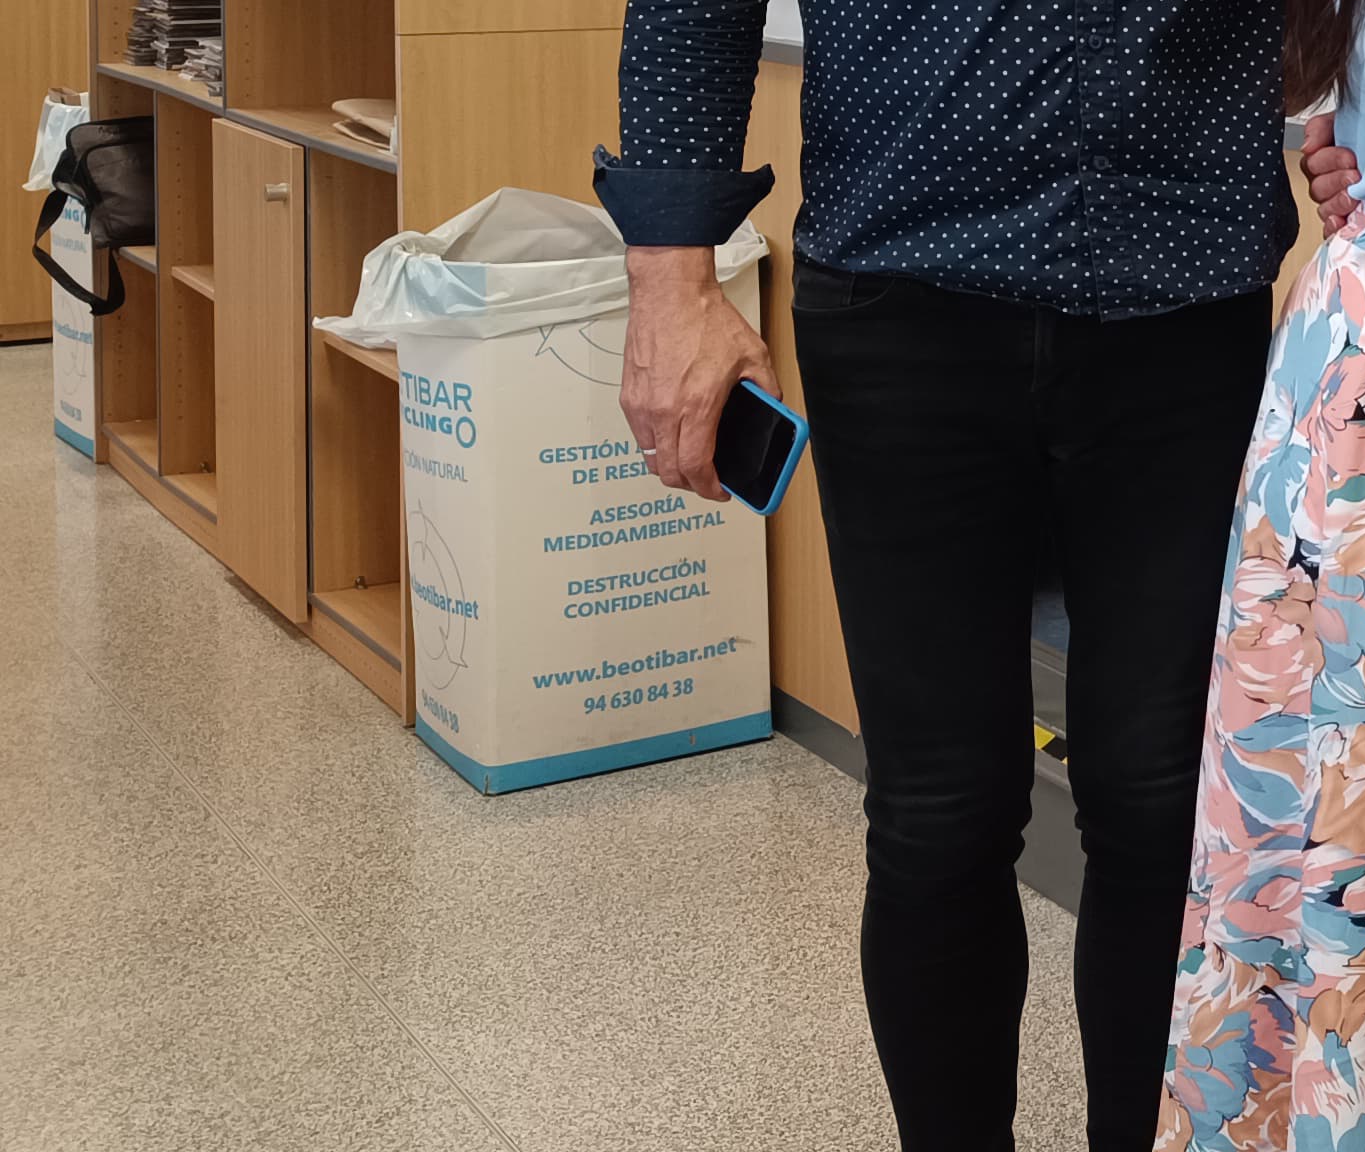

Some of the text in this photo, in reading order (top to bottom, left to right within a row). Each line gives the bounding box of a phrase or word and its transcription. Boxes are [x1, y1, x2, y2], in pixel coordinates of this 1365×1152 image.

[400, 370, 473, 413] TIBAR
[538, 439, 630, 464] GESTIÓN
[572, 460, 650, 485] DE RESI
[589, 494, 686, 526] ASESORÍA
[543, 510, 726, 553] MEDIOAMBIENTAL
[567, 558, 707, 596] DESTRUCCIÓN
[563, 581, 711, 619] CONFIDENCIAL
[532, 637, 738, 690] www.beotibar.net
[583, 678, 694, 714] 94 630 84 38
